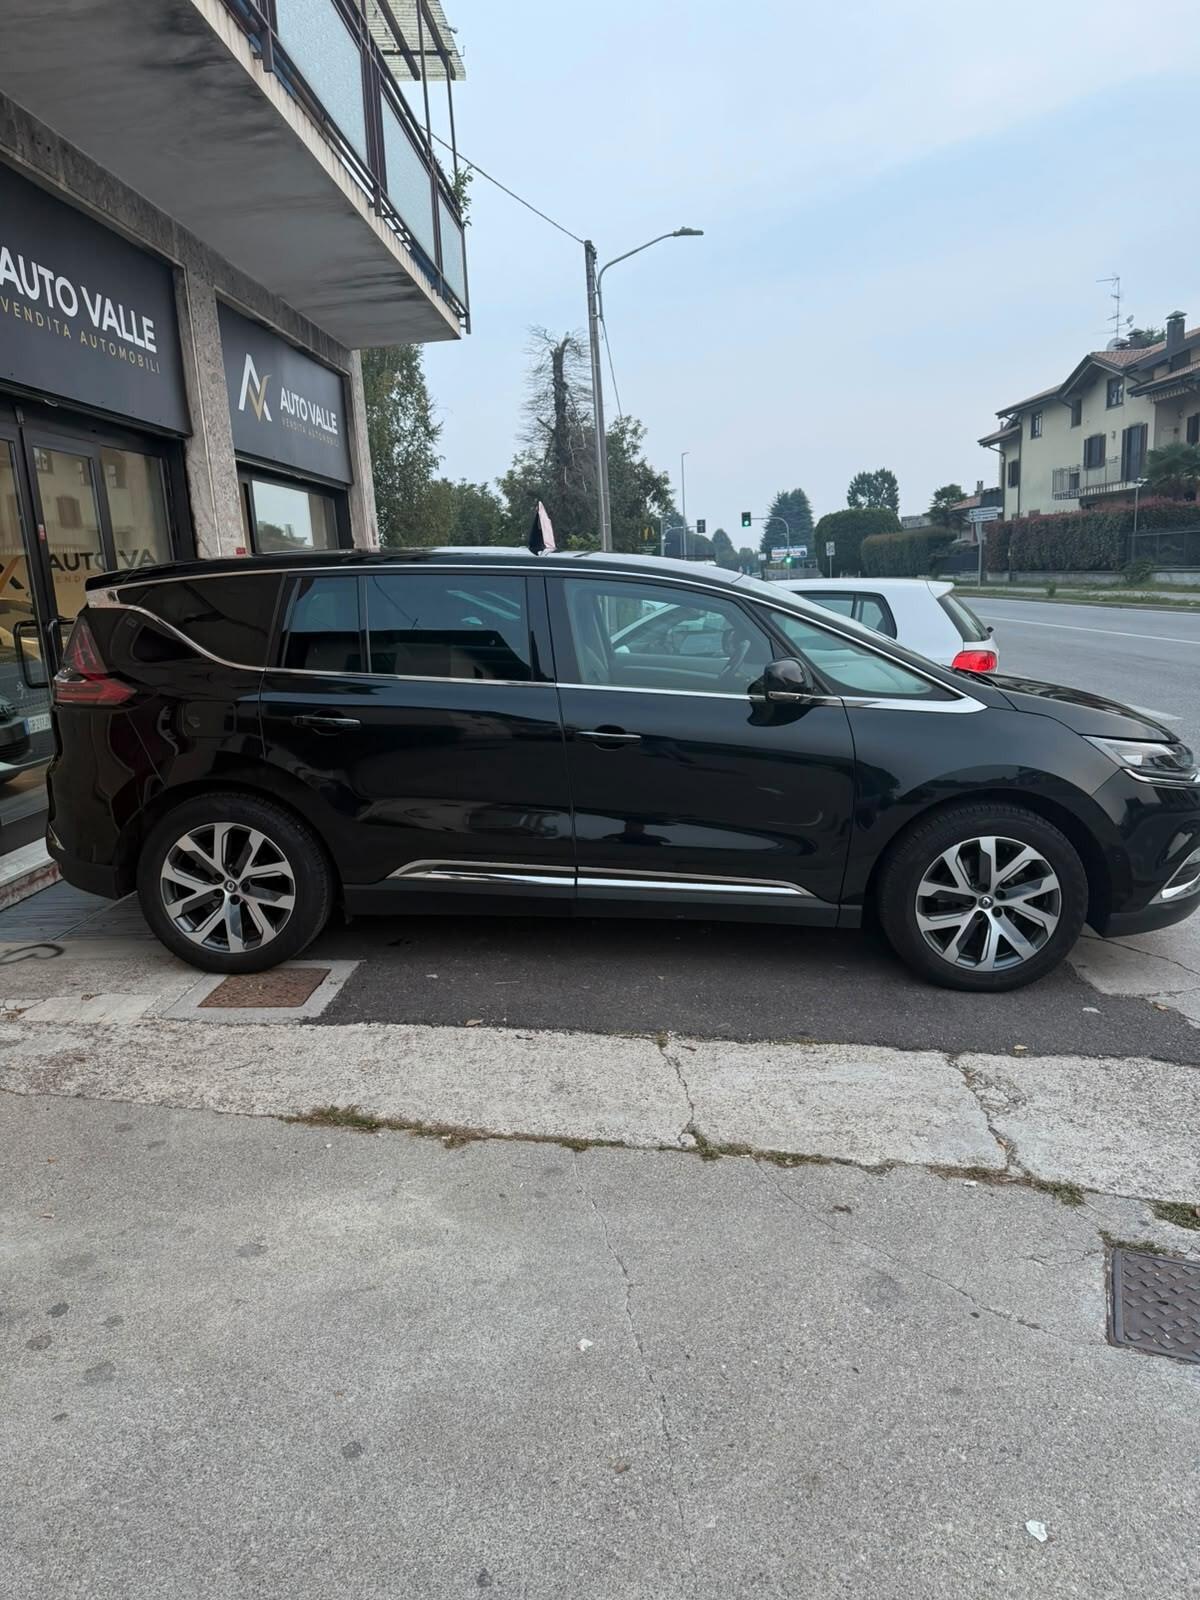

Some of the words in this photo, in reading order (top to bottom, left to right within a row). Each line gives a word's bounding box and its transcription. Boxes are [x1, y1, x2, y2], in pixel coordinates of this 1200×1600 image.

[0, 246, 78, 317] AUTO
[80, 285, 157, 353] VALLE
[0, 296, 71, 339] VENDITA
[80, 331, 160, 374] AUTOMOBILI
[280, 387, 308, 421] AUTO
[307, 400, 338, 435] VALLE
